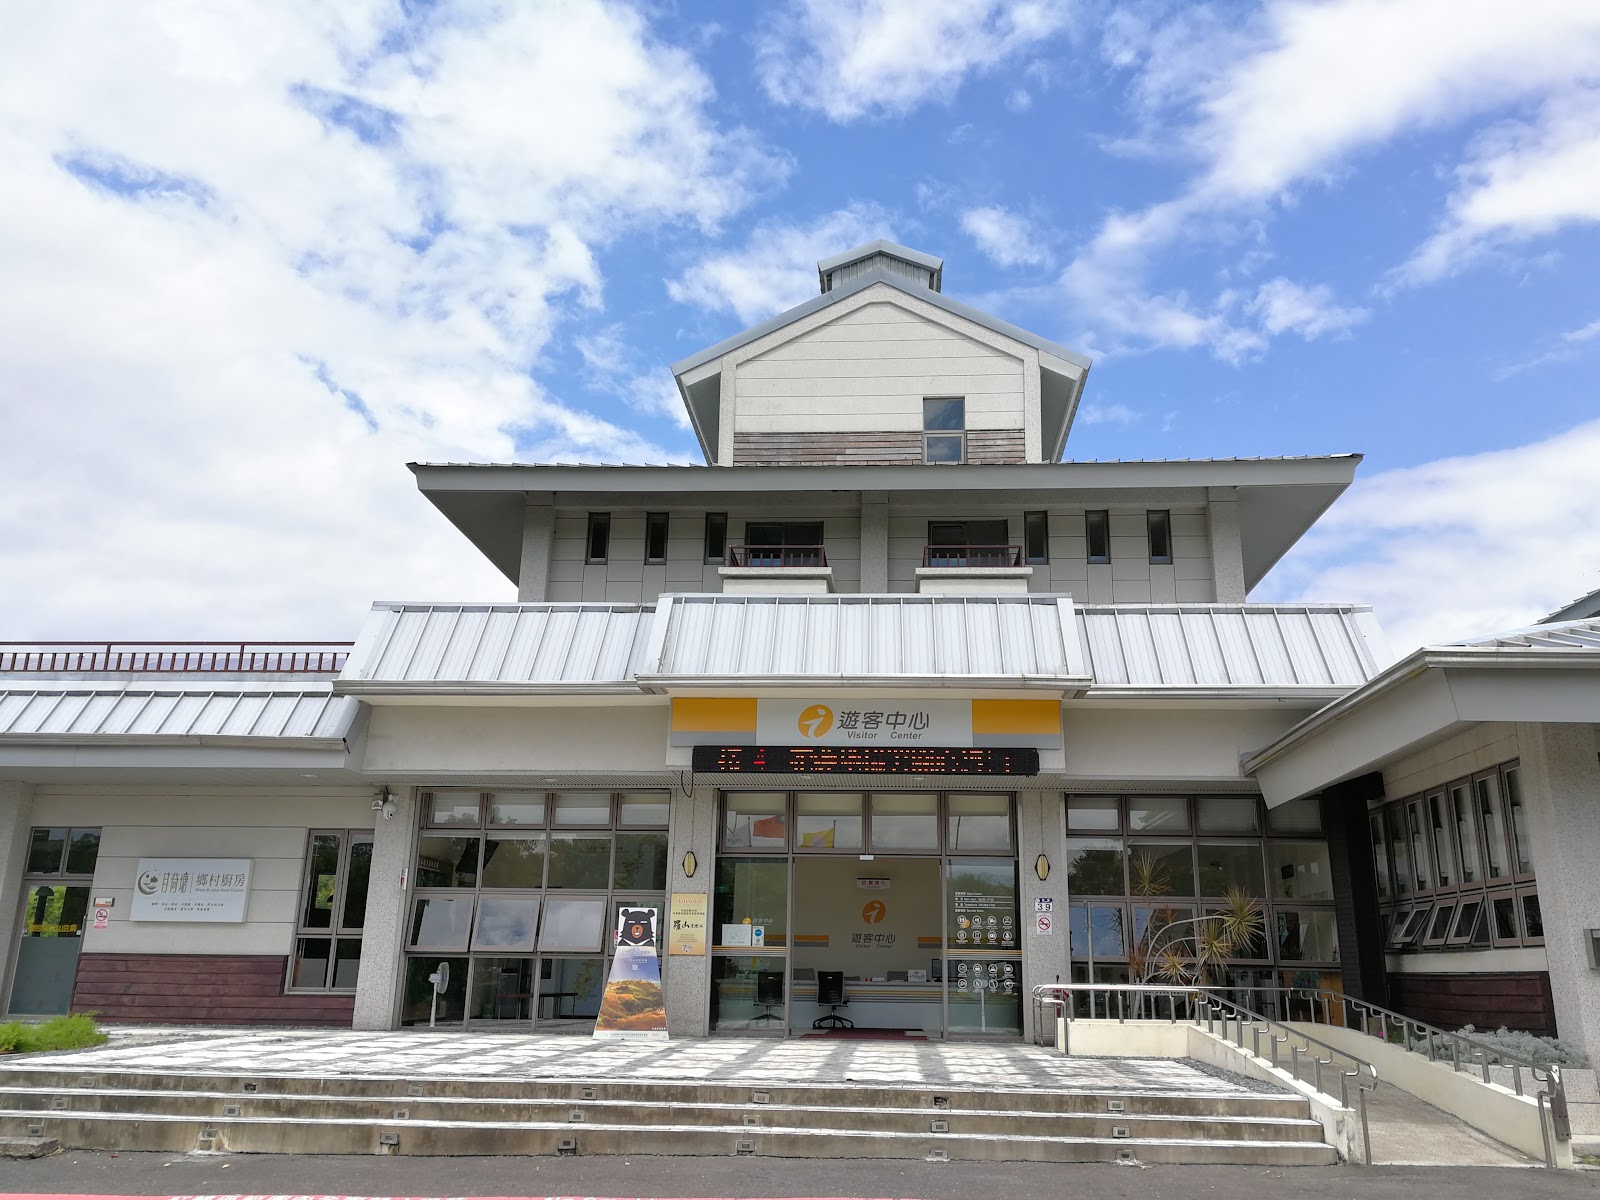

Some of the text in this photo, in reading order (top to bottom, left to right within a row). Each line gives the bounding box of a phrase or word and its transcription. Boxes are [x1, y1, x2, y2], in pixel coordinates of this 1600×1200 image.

[837, 710, 930, 730] 遊客中心
[847, 731, 923, 740] Visitor Center
[195, 873, 246, 887] 鄉村廚房
[1037, 903, 1051, 911] 39
[851, 932, 896, 944] 遊客中心
